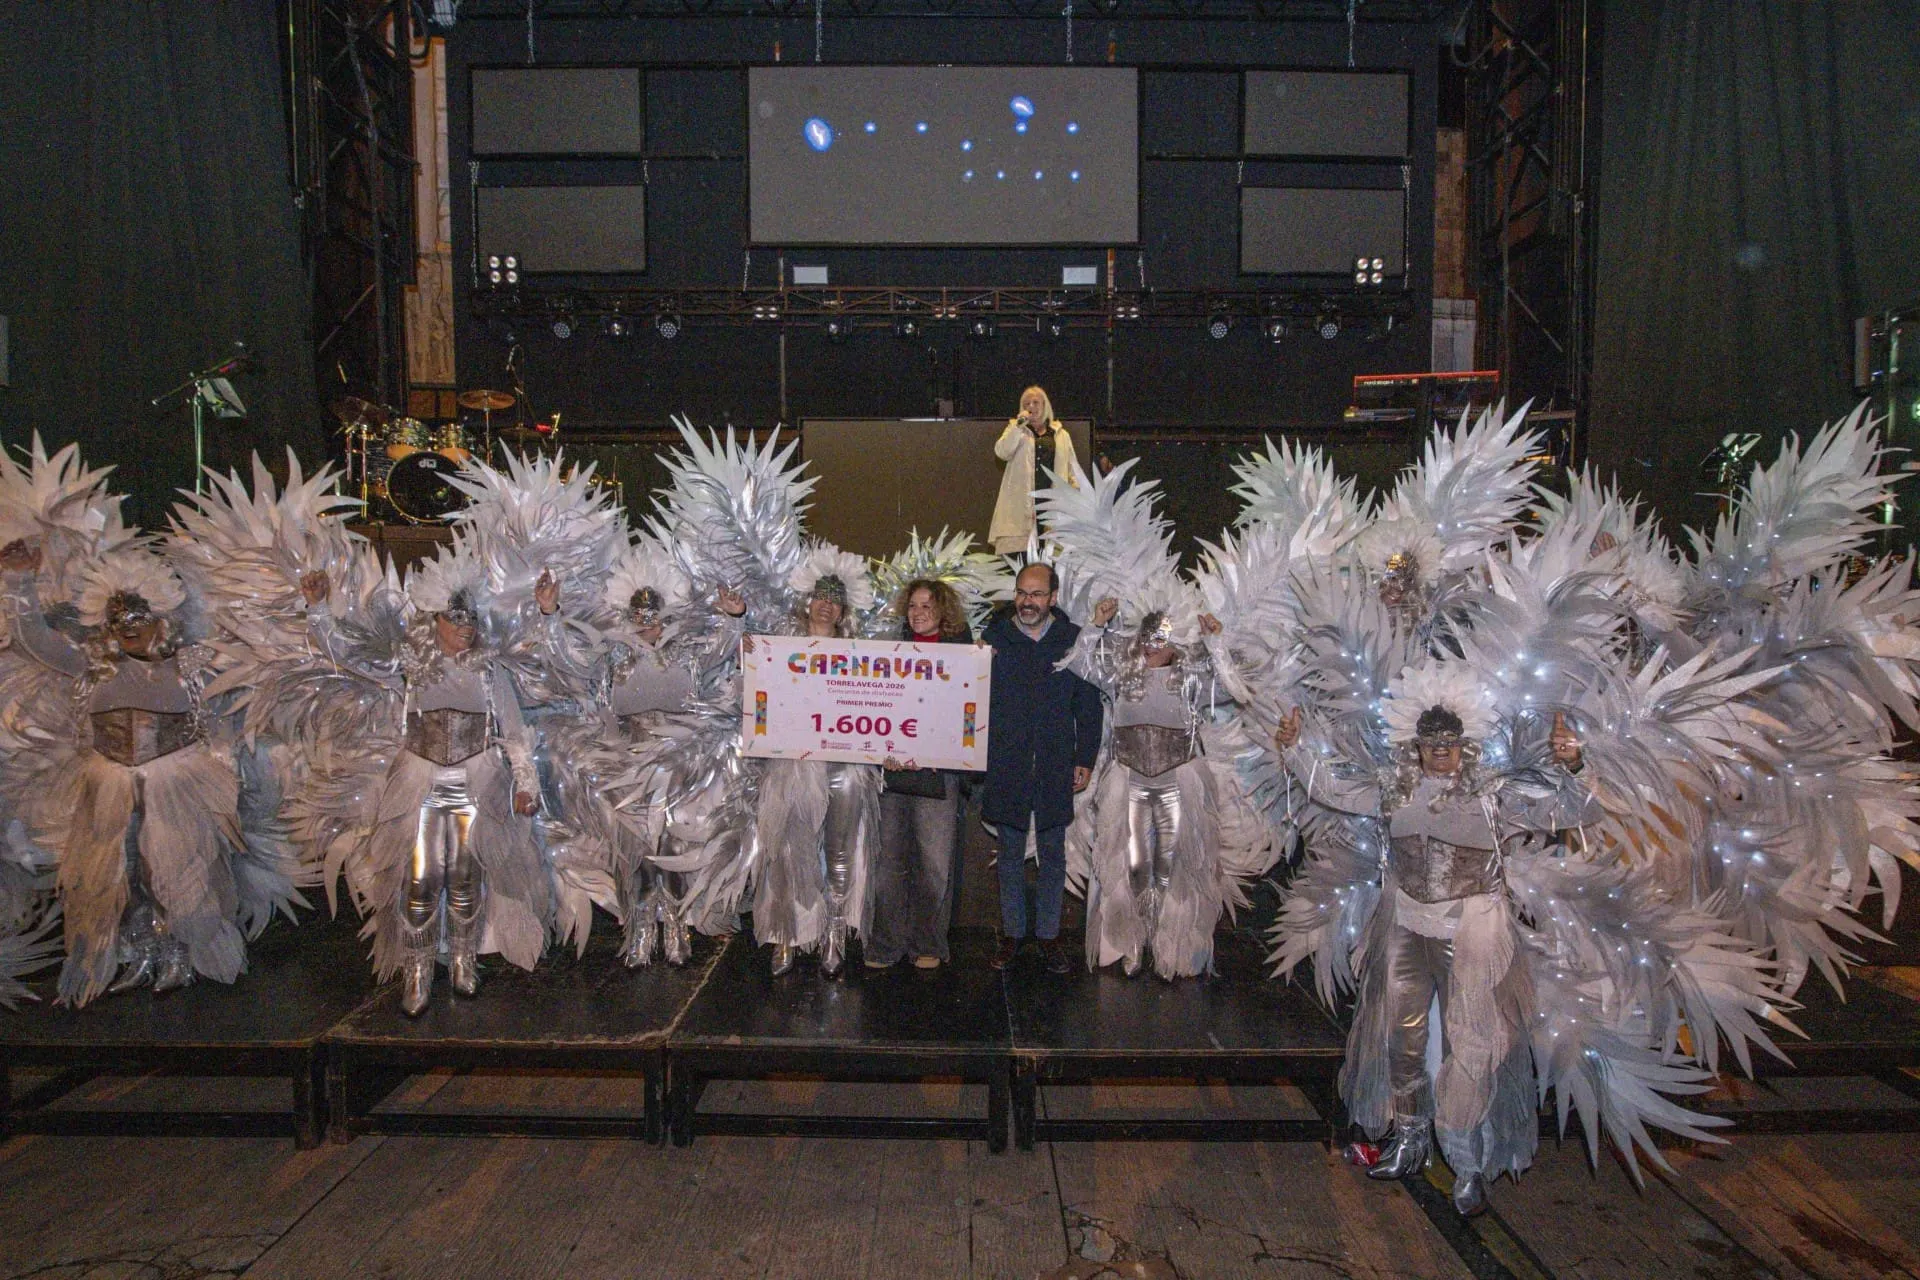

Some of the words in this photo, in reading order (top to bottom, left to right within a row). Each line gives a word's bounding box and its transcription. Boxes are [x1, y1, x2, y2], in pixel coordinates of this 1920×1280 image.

[787, 653, 951, 681] CARNAVAL
[826, 680, 883, 688] TORRELAVEGA
[885, 682, 906, 690] 2026
[811, 713, 892, 737] 1.600
[898, 718, 918, 738] €
